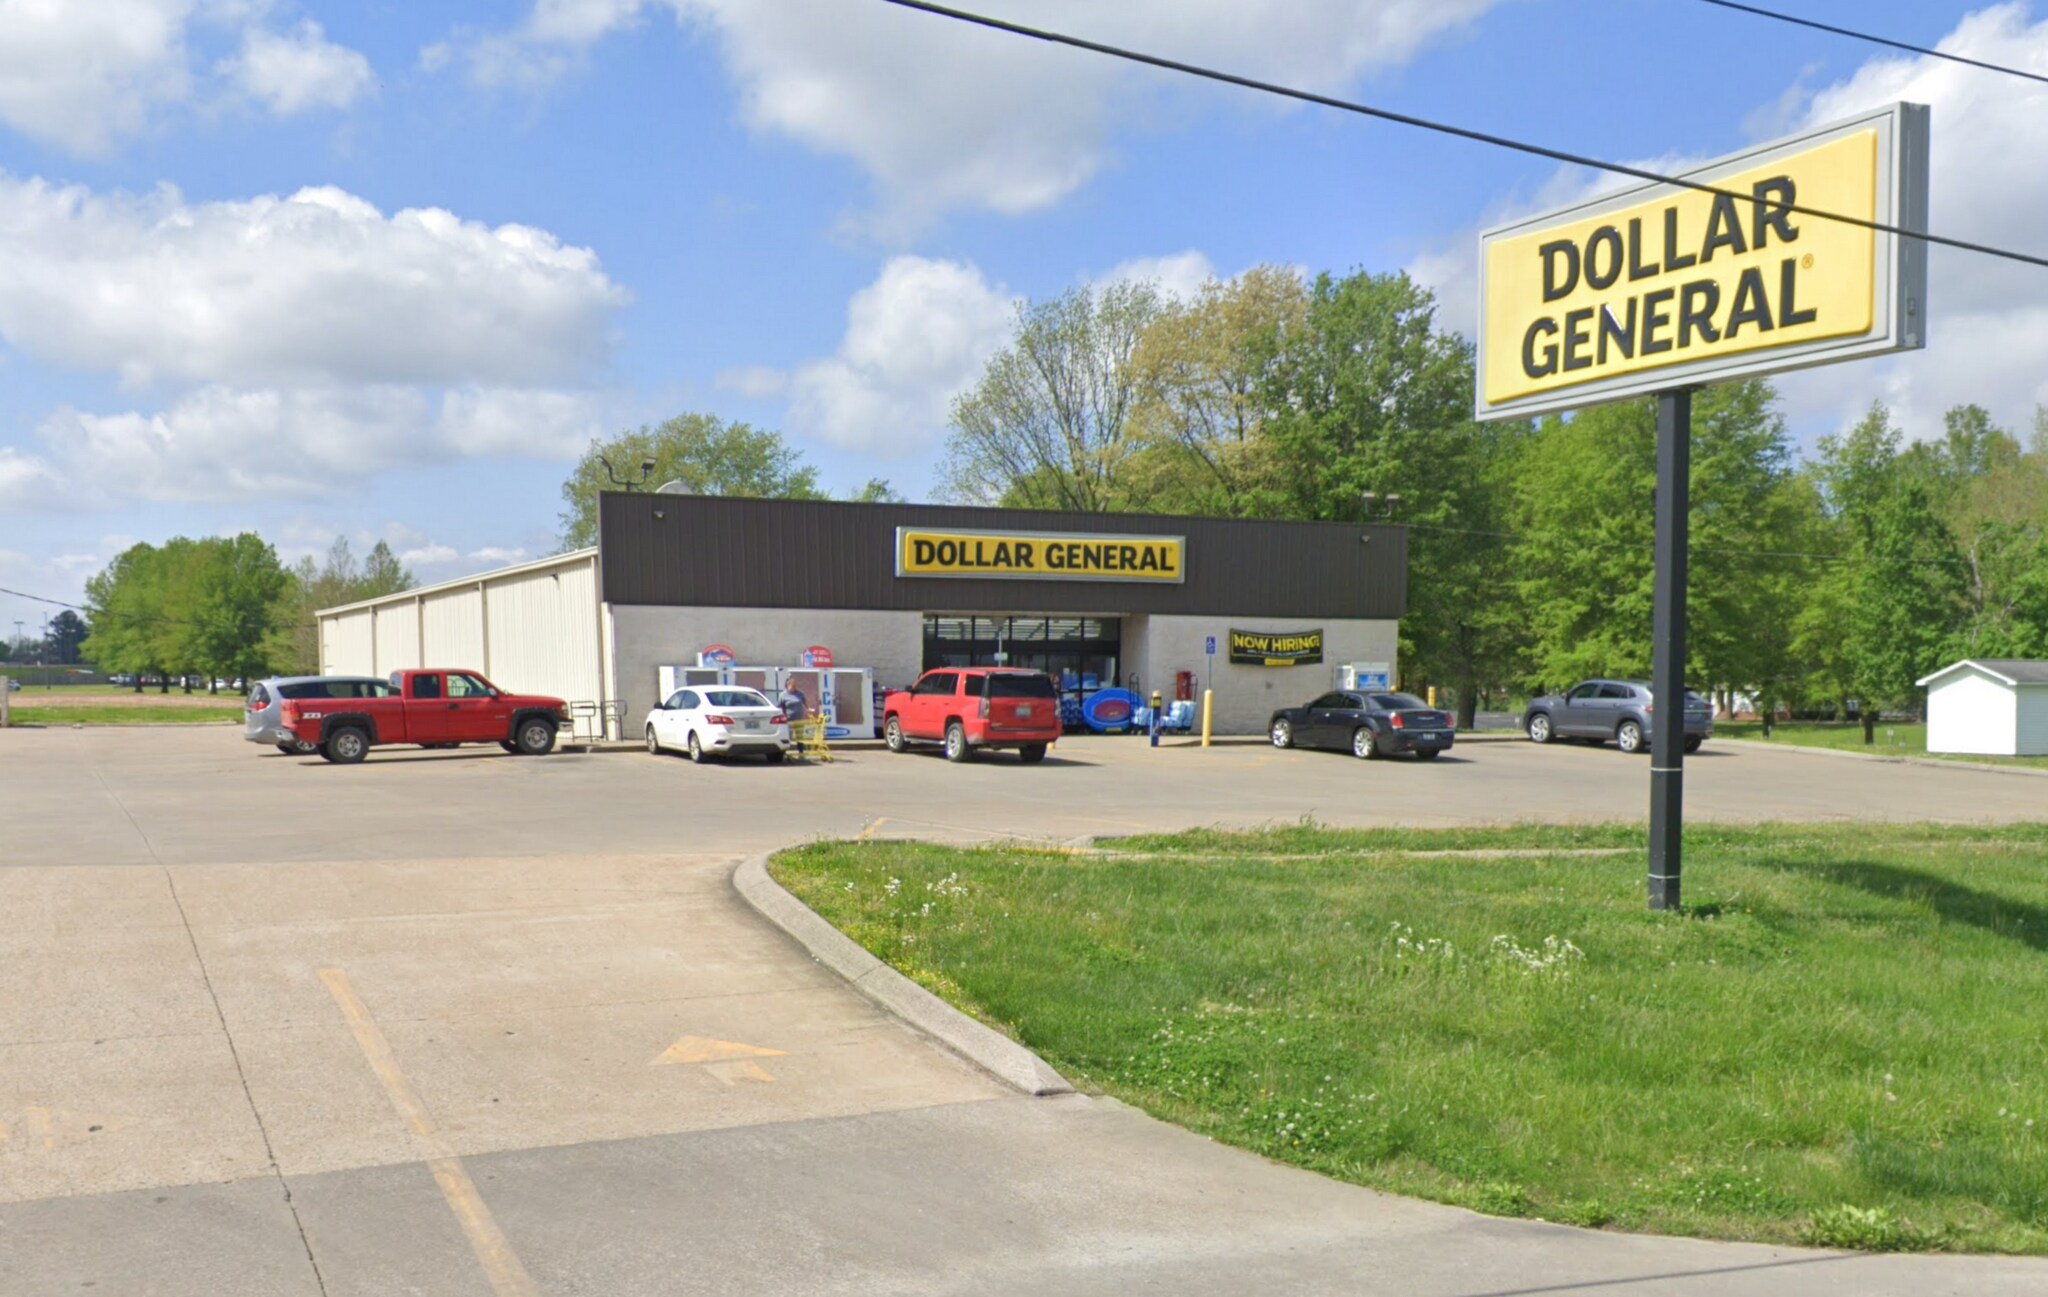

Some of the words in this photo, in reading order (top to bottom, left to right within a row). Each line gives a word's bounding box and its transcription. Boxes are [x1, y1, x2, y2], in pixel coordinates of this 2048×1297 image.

[1539, 174, 1799, 303] DOLLAR
[1522, 257, 1817, 379] GENERAL
[913, 540, 1034, 568] DOLLAR
[1045, 543, 1174, 571] GENERAL
[1234, 634, 1268, 650] NOW
